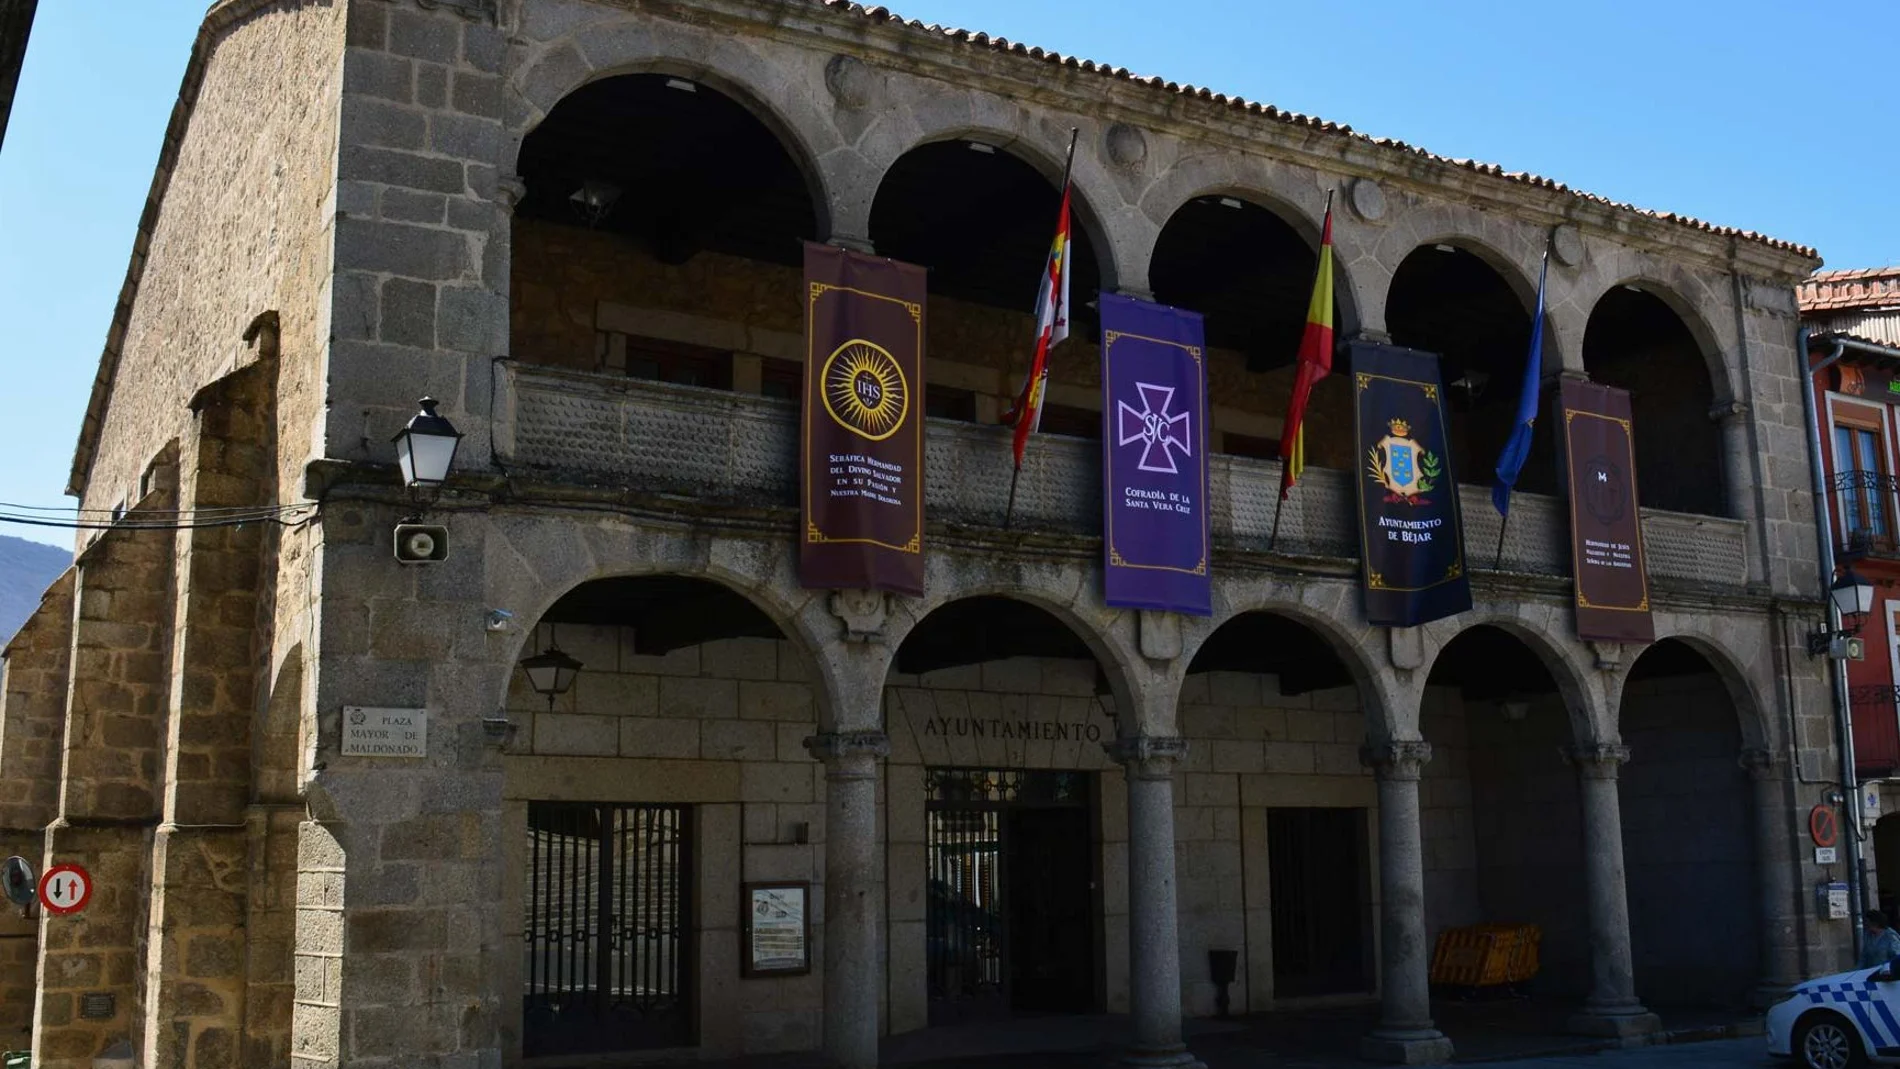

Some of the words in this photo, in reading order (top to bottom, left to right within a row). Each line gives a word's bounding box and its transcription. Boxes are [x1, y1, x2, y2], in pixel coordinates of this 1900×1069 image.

[1125, 486, 1165, 501] COFRADÍA
[1170, 493, 1179, 502] DE
[1182, 494, 1190, 504] LA
[1125, 498, 1149, 509] SANTA
[1152, 500, 1173, 511] VERA
[1175, 503, 1191, 515] CRUZ
[1378, 516, 1442, 529] AYUNTAMIENTO
[1388, 531, 1398, 541] DE
[1402, 530, 1432, 545] BÉJAR
[382, 717, 412, 725] PLAZA
[351, 730, 389, 739] MAYOR
[405, 731, 418, 740] DE
[924, 718, 1101, 742] AYUNTAMIENTO
[350, 744, 418, 754] MALDONADO
